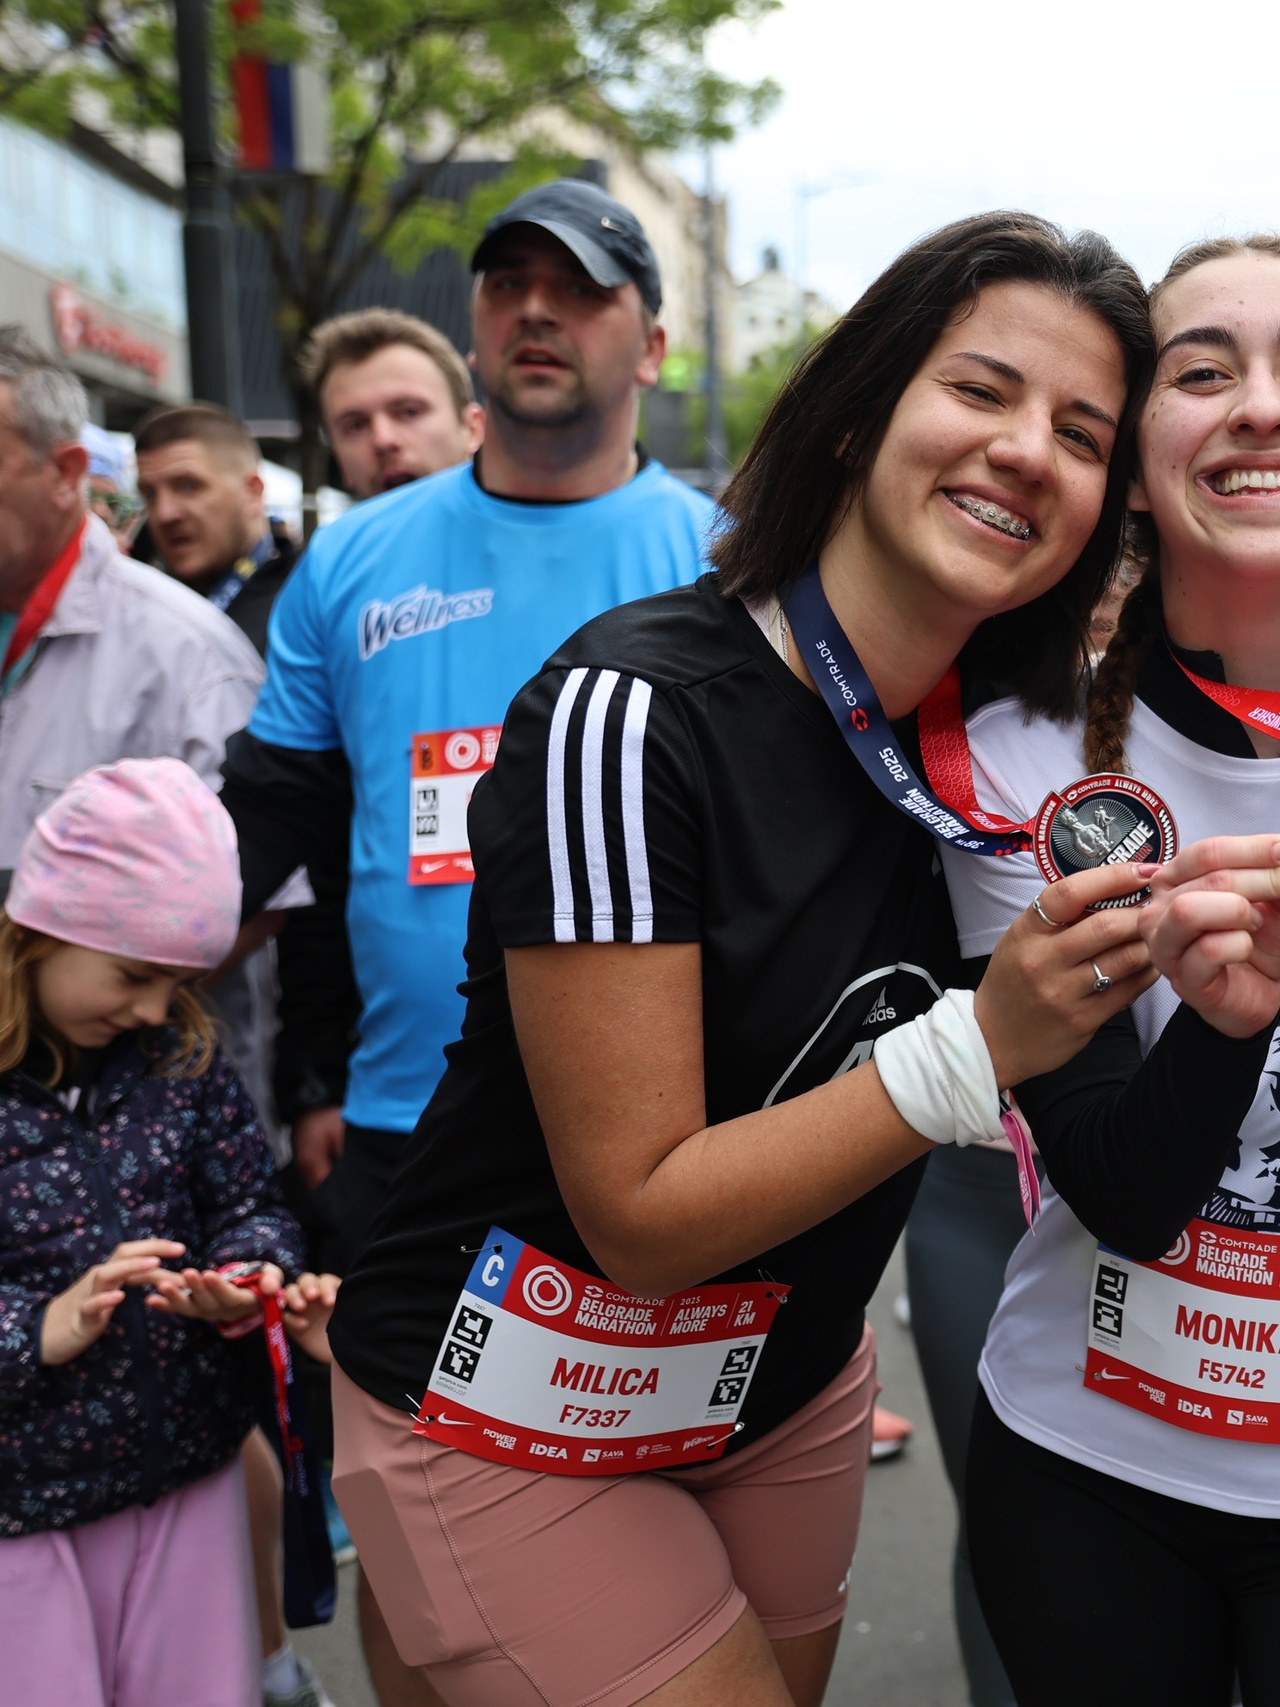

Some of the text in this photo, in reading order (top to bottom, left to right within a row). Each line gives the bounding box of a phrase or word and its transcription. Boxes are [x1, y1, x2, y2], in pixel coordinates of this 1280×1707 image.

[361, 587, 491, 658] Wellness
[815, 639, 858, 707] COMTRADE
[878, 746, 909, 783] 2025
[1114, 779, 1142, 794] ALWAYS
[1140, 790, 1159, 808] MORE
[898, 796, 958, 840] BELGRADE
[905, 787, 970, 836] MARATHON
[1100, 820, 1155, 867] GRADE
[1197, 1243, 1268, 1270] BELGRADE
[1218, 1236, 1278, 1254] COMTRADE
[481, 1254, 505, 1287] C
[1195, 1257, 1274, 1286] MARATHON
[579, 1296, 654, 1323] BELGRADE
[605, 1291, 666, 1307] COMTRADE
[680, 1295, 701, 1306] 2025
[738, 1300, 754, 1315] 21
[574, 1310, 657, 1336] MARATHON
[674, 1303, 728, 1322] ALWAYS
[733, 1311, 756, 1327] KM
[669, 1318, 708, 1335] MORE
[549, 1356, 661, 1396] MILICA
[1197, 1358, 1267, 1390] F5742
[1138, 1382, 1167, 1399] POWER
[558, 1404, 631, 1428] F7337
[1245, 1413, 1269, 1424] SAVA
[482, 1428, 517, 1444] POWER
[601, 1449, 625, 1459] SAVA
